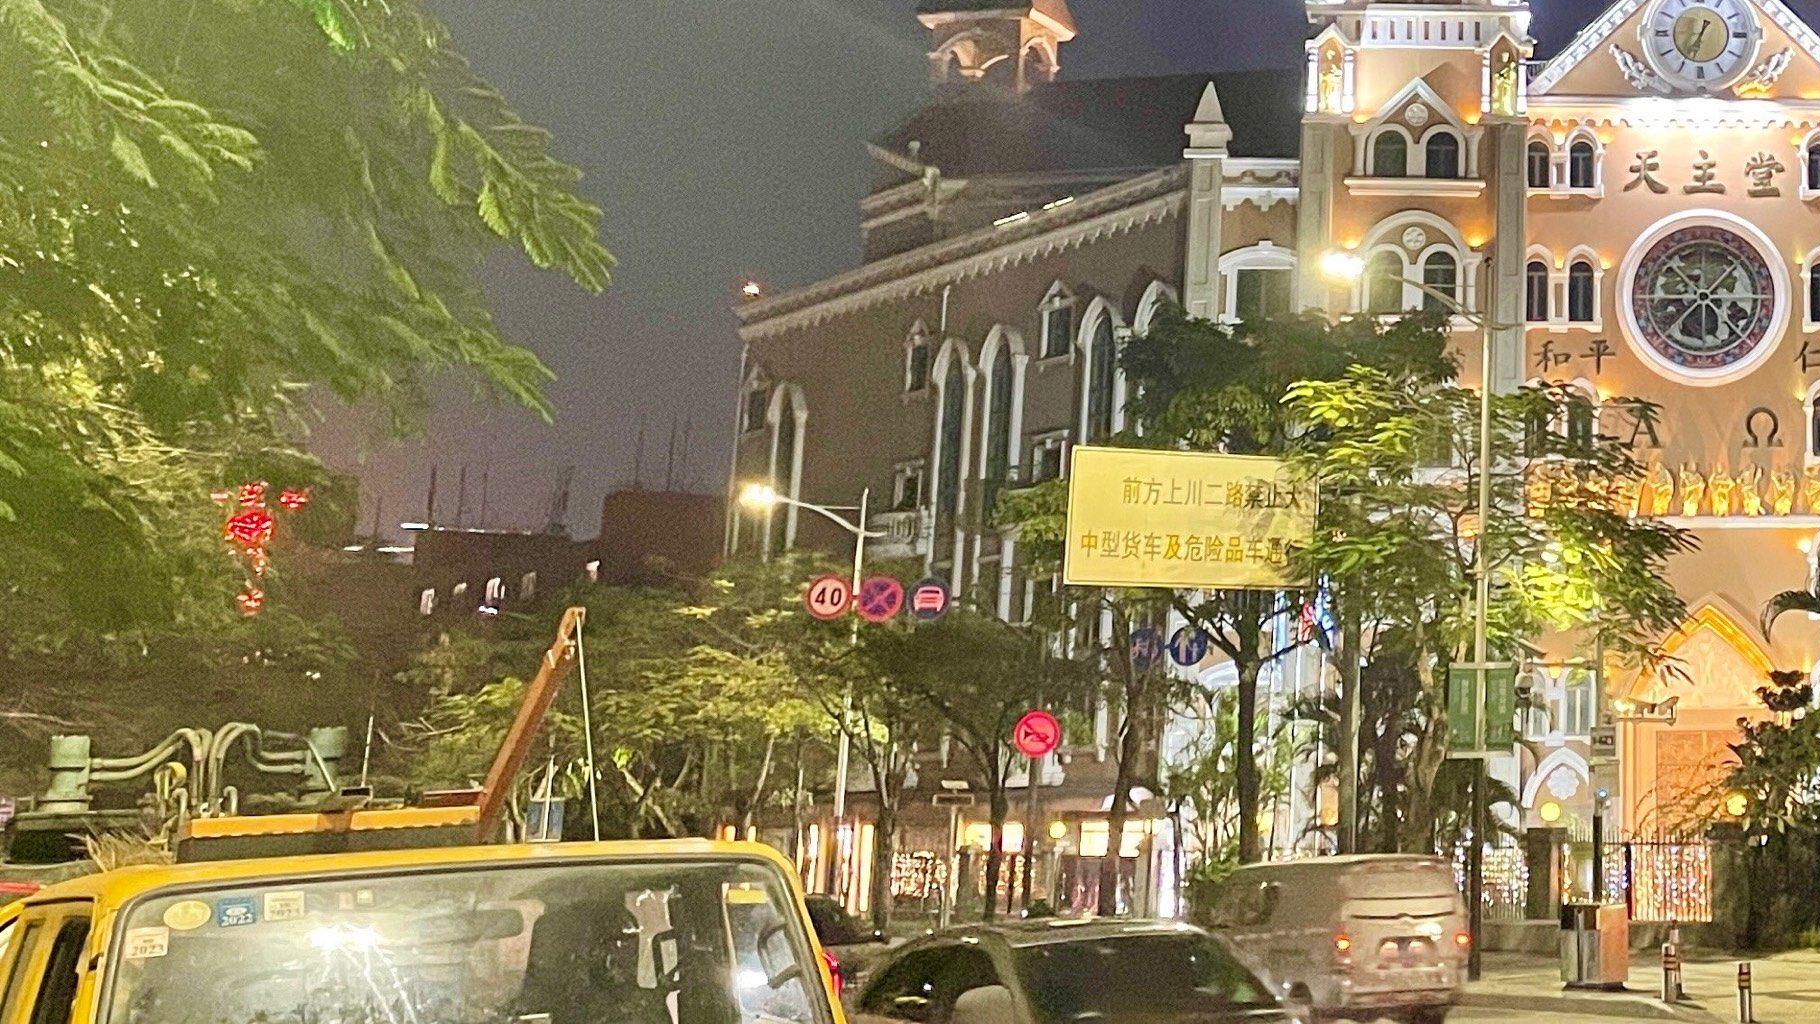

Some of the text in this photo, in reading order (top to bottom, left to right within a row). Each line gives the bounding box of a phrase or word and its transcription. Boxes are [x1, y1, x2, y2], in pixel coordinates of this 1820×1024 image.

[1624, 149, 1785, 198] 天主堂
[1533, 340, 1616, 375] 和平
[1742, 406, 1784, 448] Ω
[1122, 476, 1302, 510] 前方上川二路禁止大
[815, 587, 842, 606] 40
